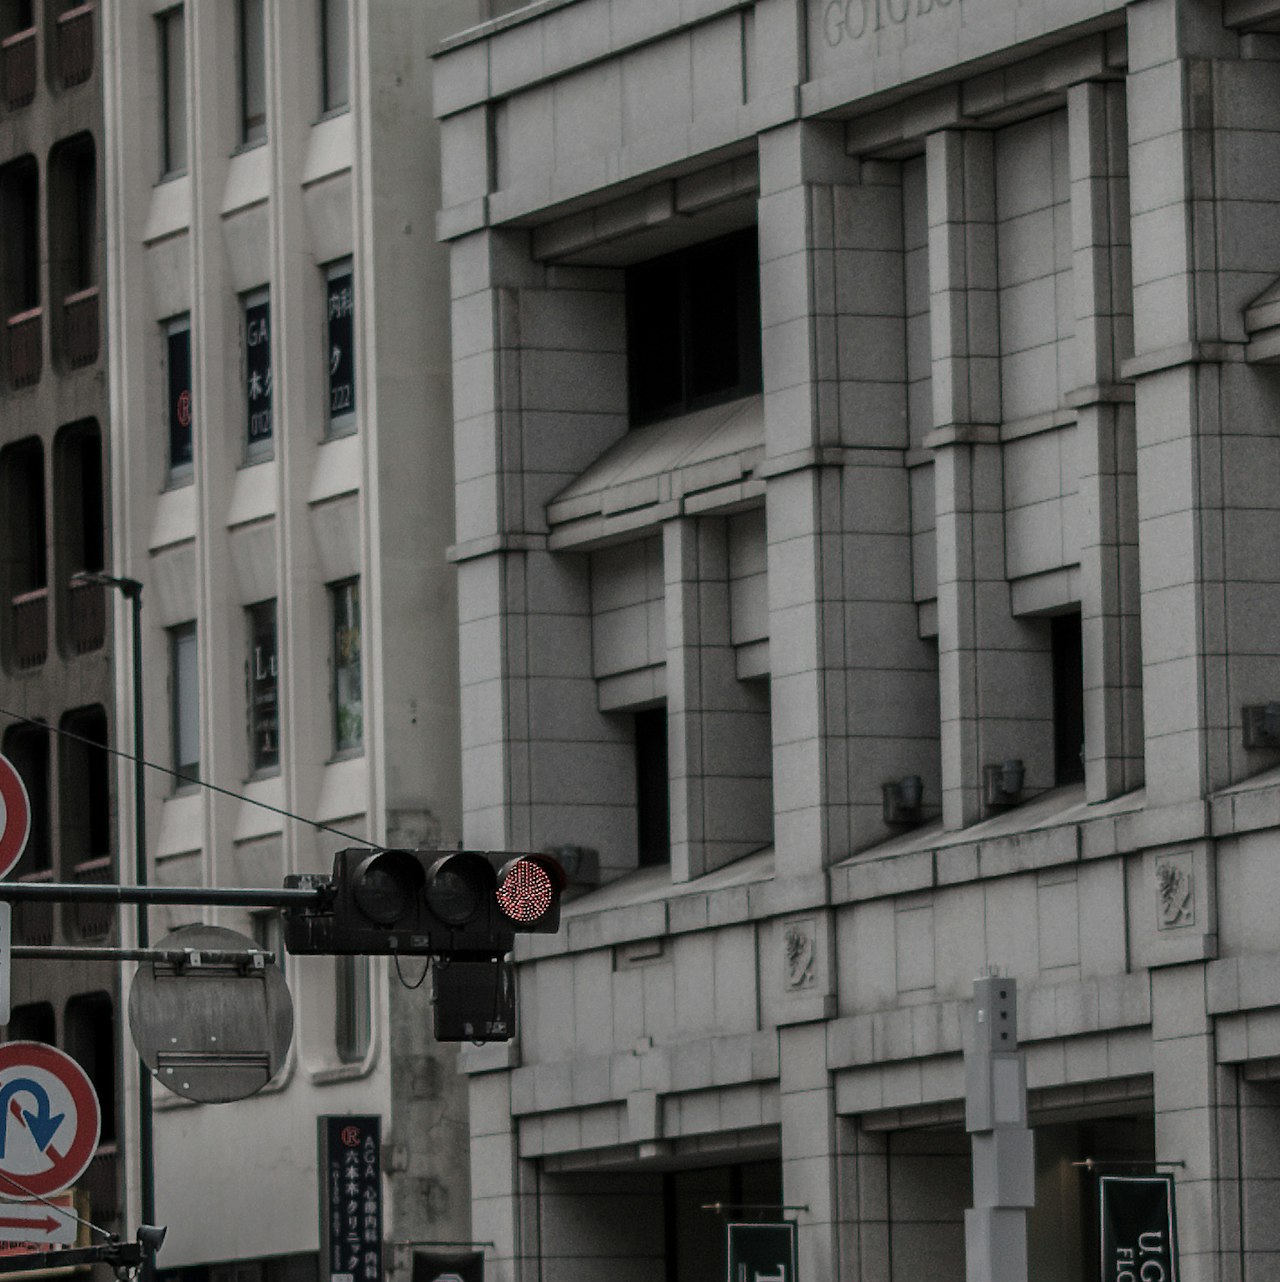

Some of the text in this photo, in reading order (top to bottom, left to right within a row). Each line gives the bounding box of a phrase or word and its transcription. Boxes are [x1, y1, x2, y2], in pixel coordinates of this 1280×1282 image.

[343, 1150, 362, 1271] 六本木クリニック
